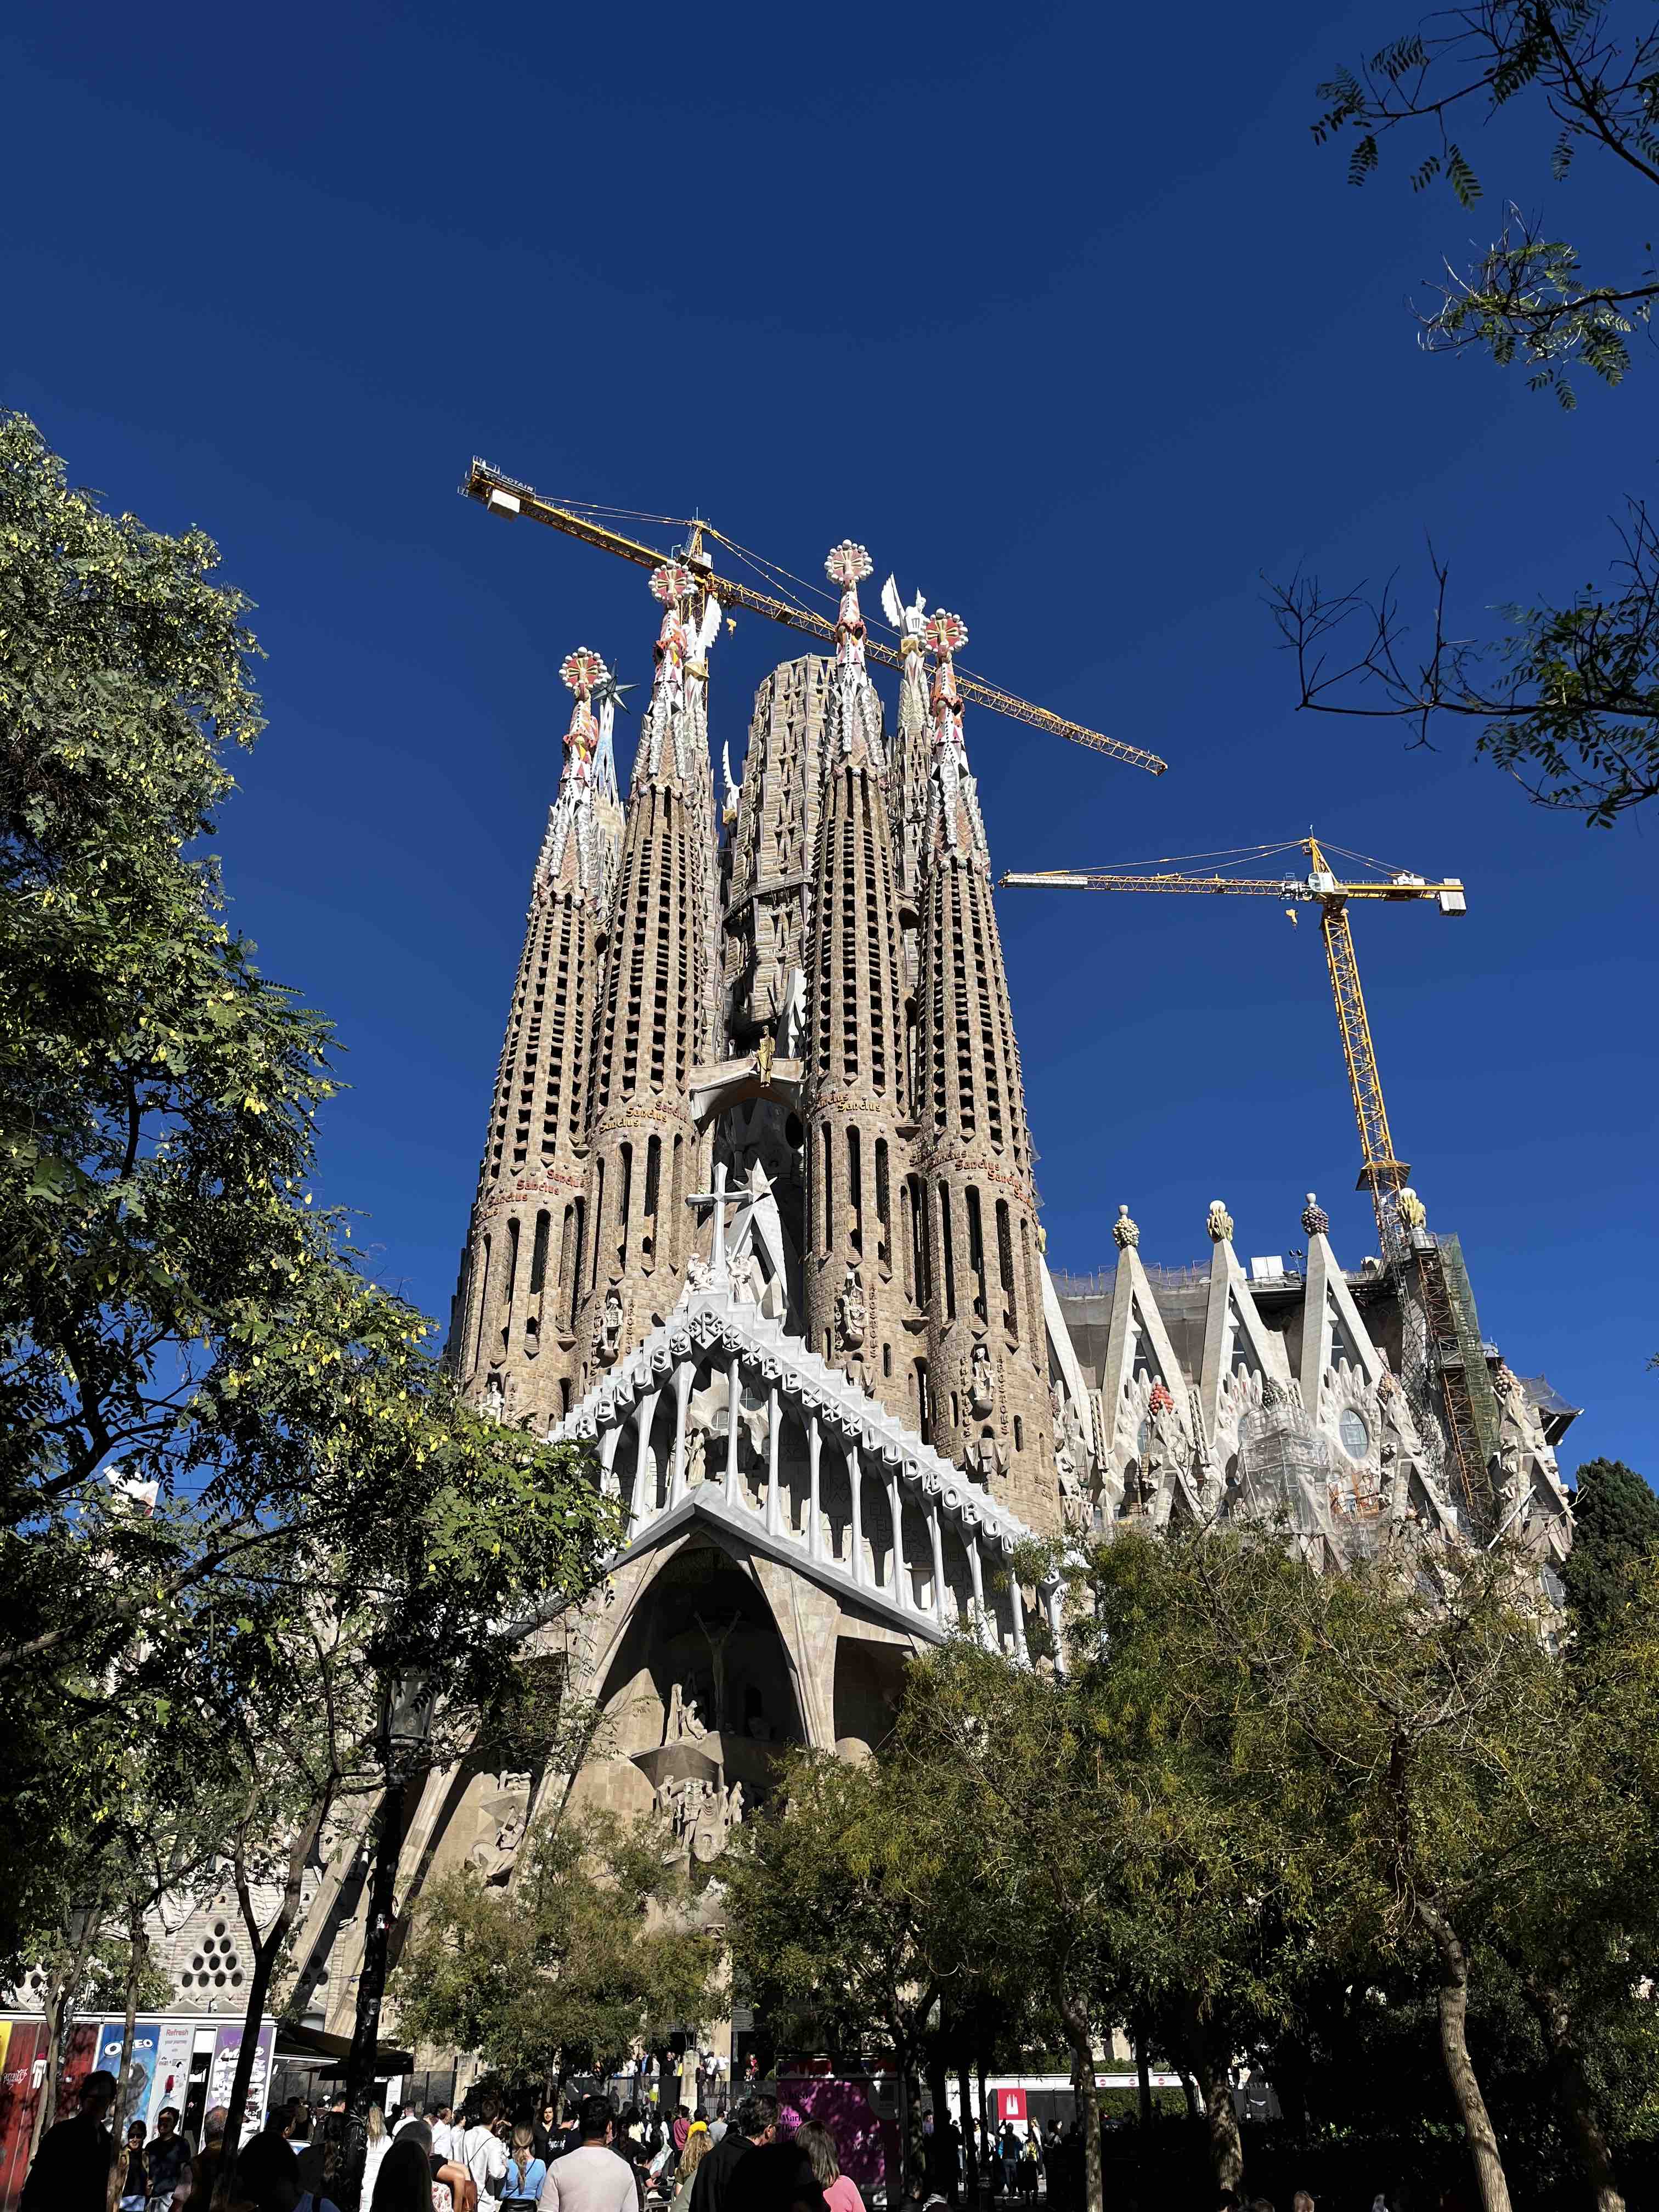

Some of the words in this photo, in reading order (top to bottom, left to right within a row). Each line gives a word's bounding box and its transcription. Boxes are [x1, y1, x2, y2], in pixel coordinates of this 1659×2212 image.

[501, 475, 533, 492] POTAIN
[626, 1106, 668, 1124] Sanctus
[838, 1101, 882, 1112] Sanctus
[955, 1158, 1001, 1171] Sanctus
[516, 1179, 560, 1195] Sanctus
[625, 1299, 635, 1355] APOSTO
[763, 1356, 821, 1405] REX
[577, 1347, 669, 1437] RENUS
[166, 2028, 188, 2036] Refresh
[103, 2038, 153, 2057] OEO
